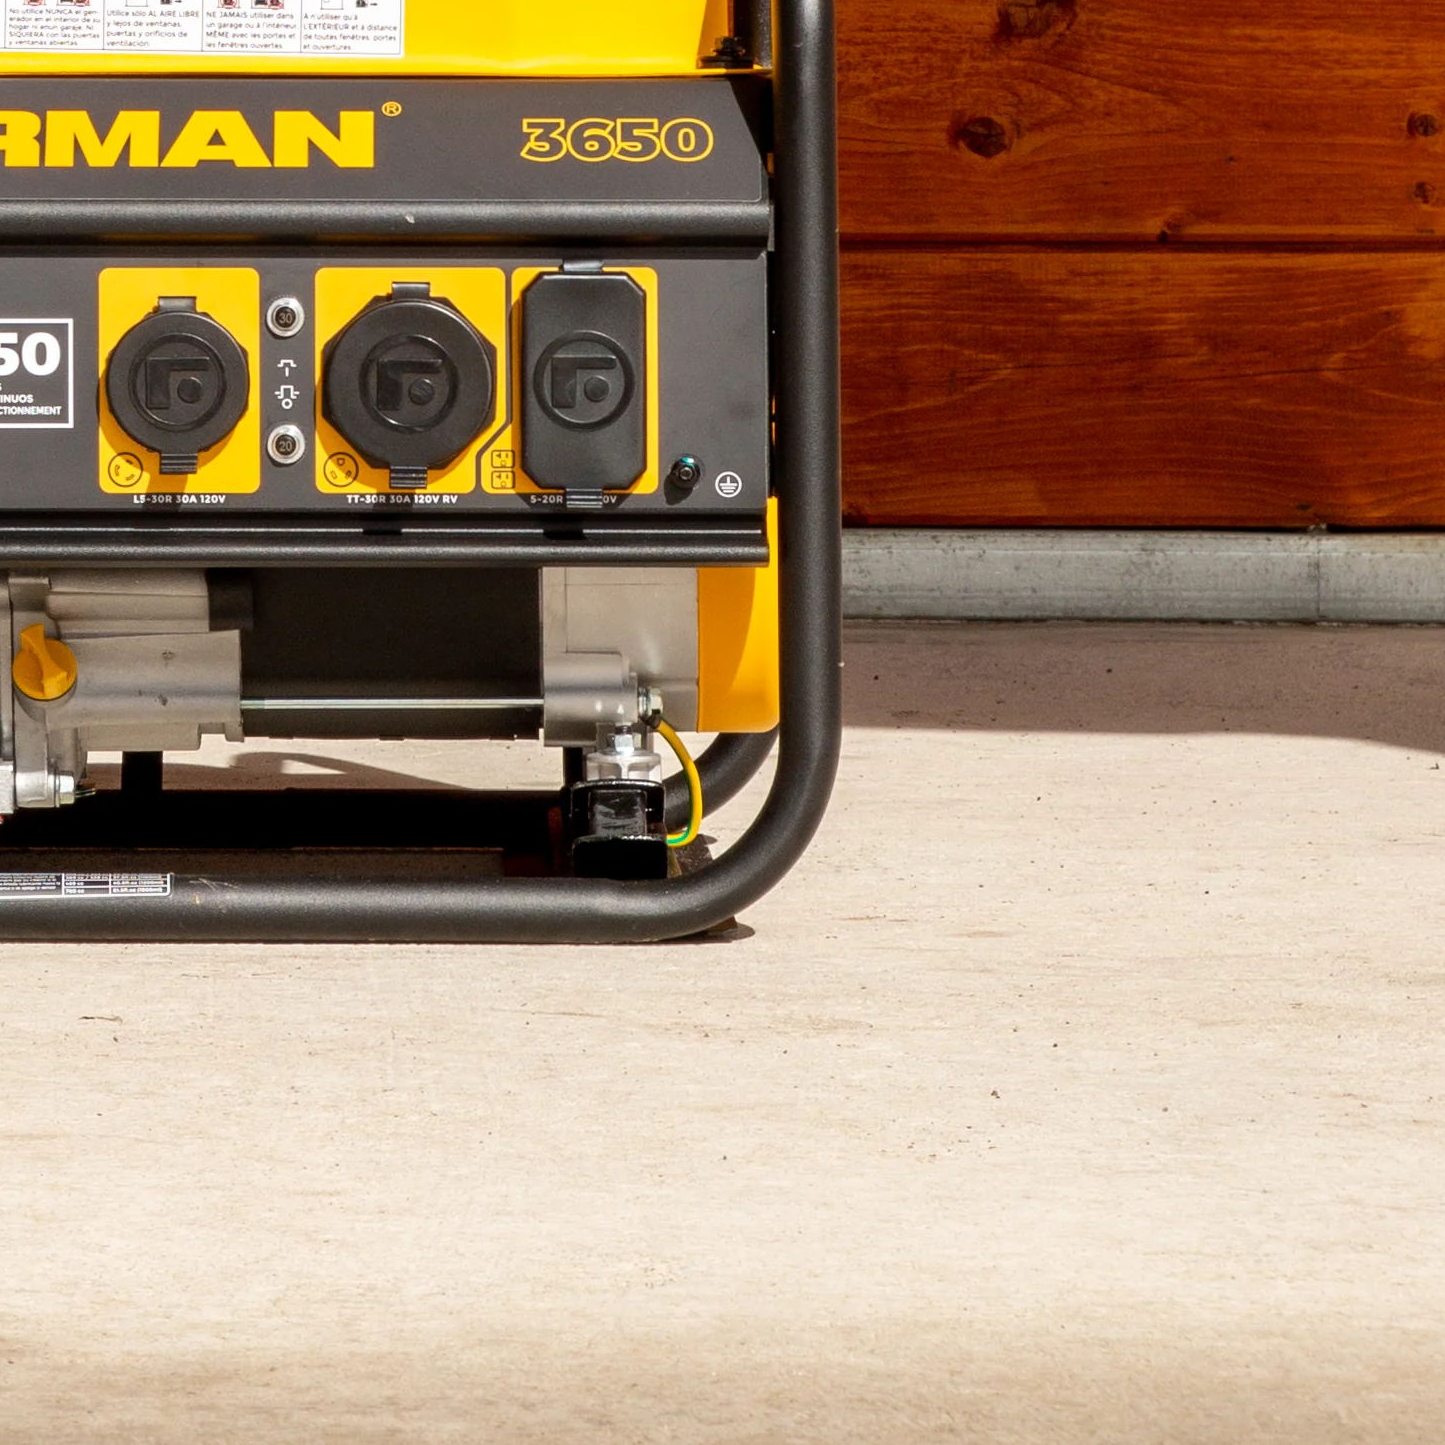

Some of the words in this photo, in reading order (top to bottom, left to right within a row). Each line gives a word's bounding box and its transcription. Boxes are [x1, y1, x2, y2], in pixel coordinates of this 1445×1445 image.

[520, 118, 714, 162] 3650
[279, 312, 293, 324] 30
[279, 440, 293, 452] 20
[133, 495, 172, 503] L5-30R
[176, 495, 197, 503] 30A
[199, 495, 226, 503] 120V
[346, 495, 386, 504] TT-30R
[389, 495, 411, 503] 30A
[414, 495, 440, 504] 120V
[442, 495, 458, 504] RV
[530, 495, 563, 503] 5-20R
